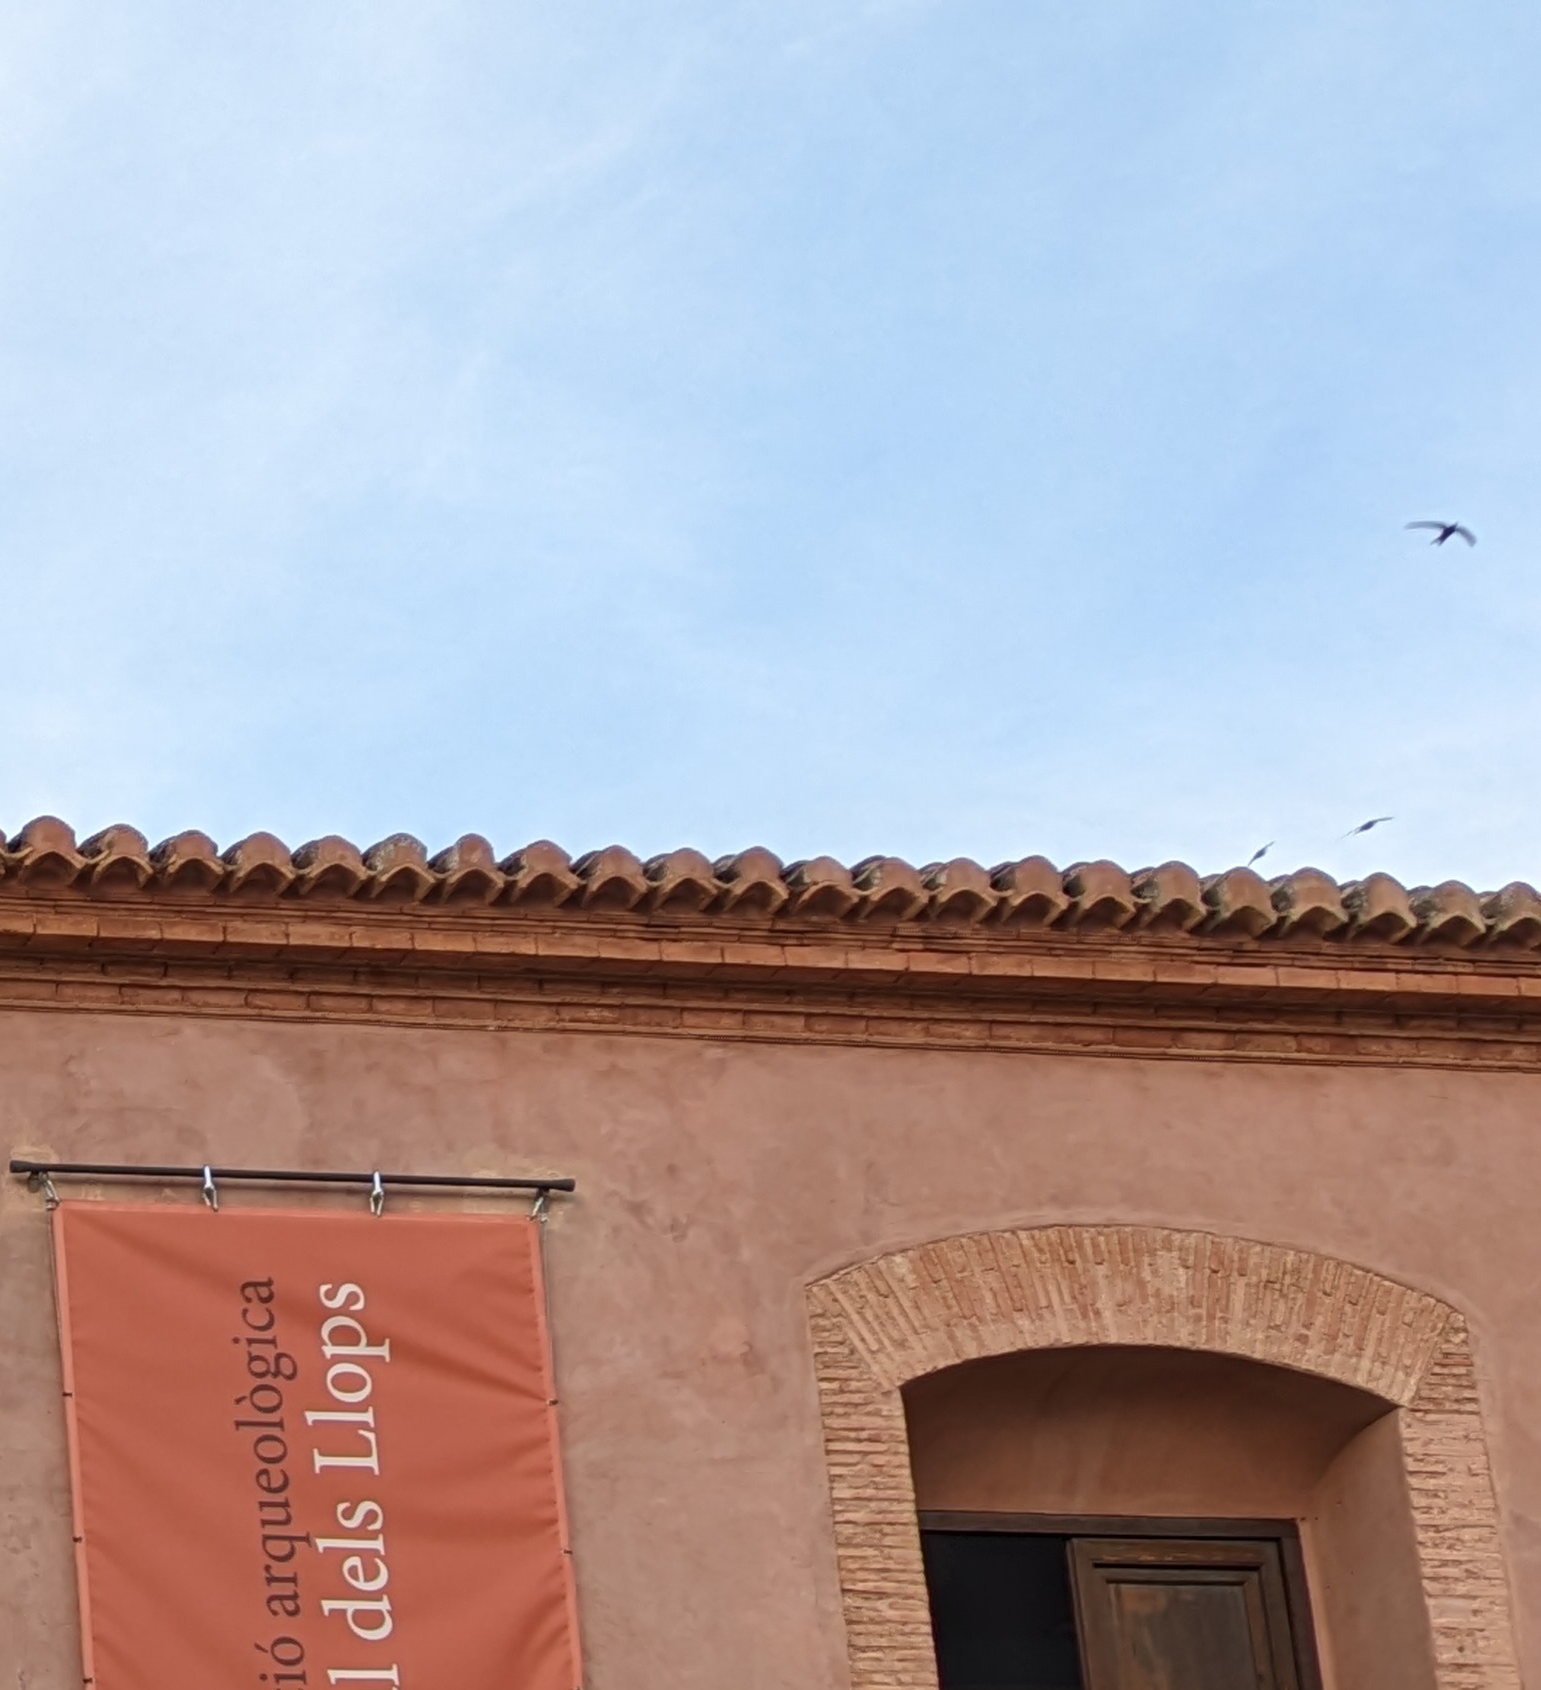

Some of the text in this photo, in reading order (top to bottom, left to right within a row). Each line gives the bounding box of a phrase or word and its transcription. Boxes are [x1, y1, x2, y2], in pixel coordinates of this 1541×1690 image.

[231, 1276, 313, 1618] arqueològica
[303, 1282, 391, 1475] Llops
[313, 1500, 394, 1641] dels
